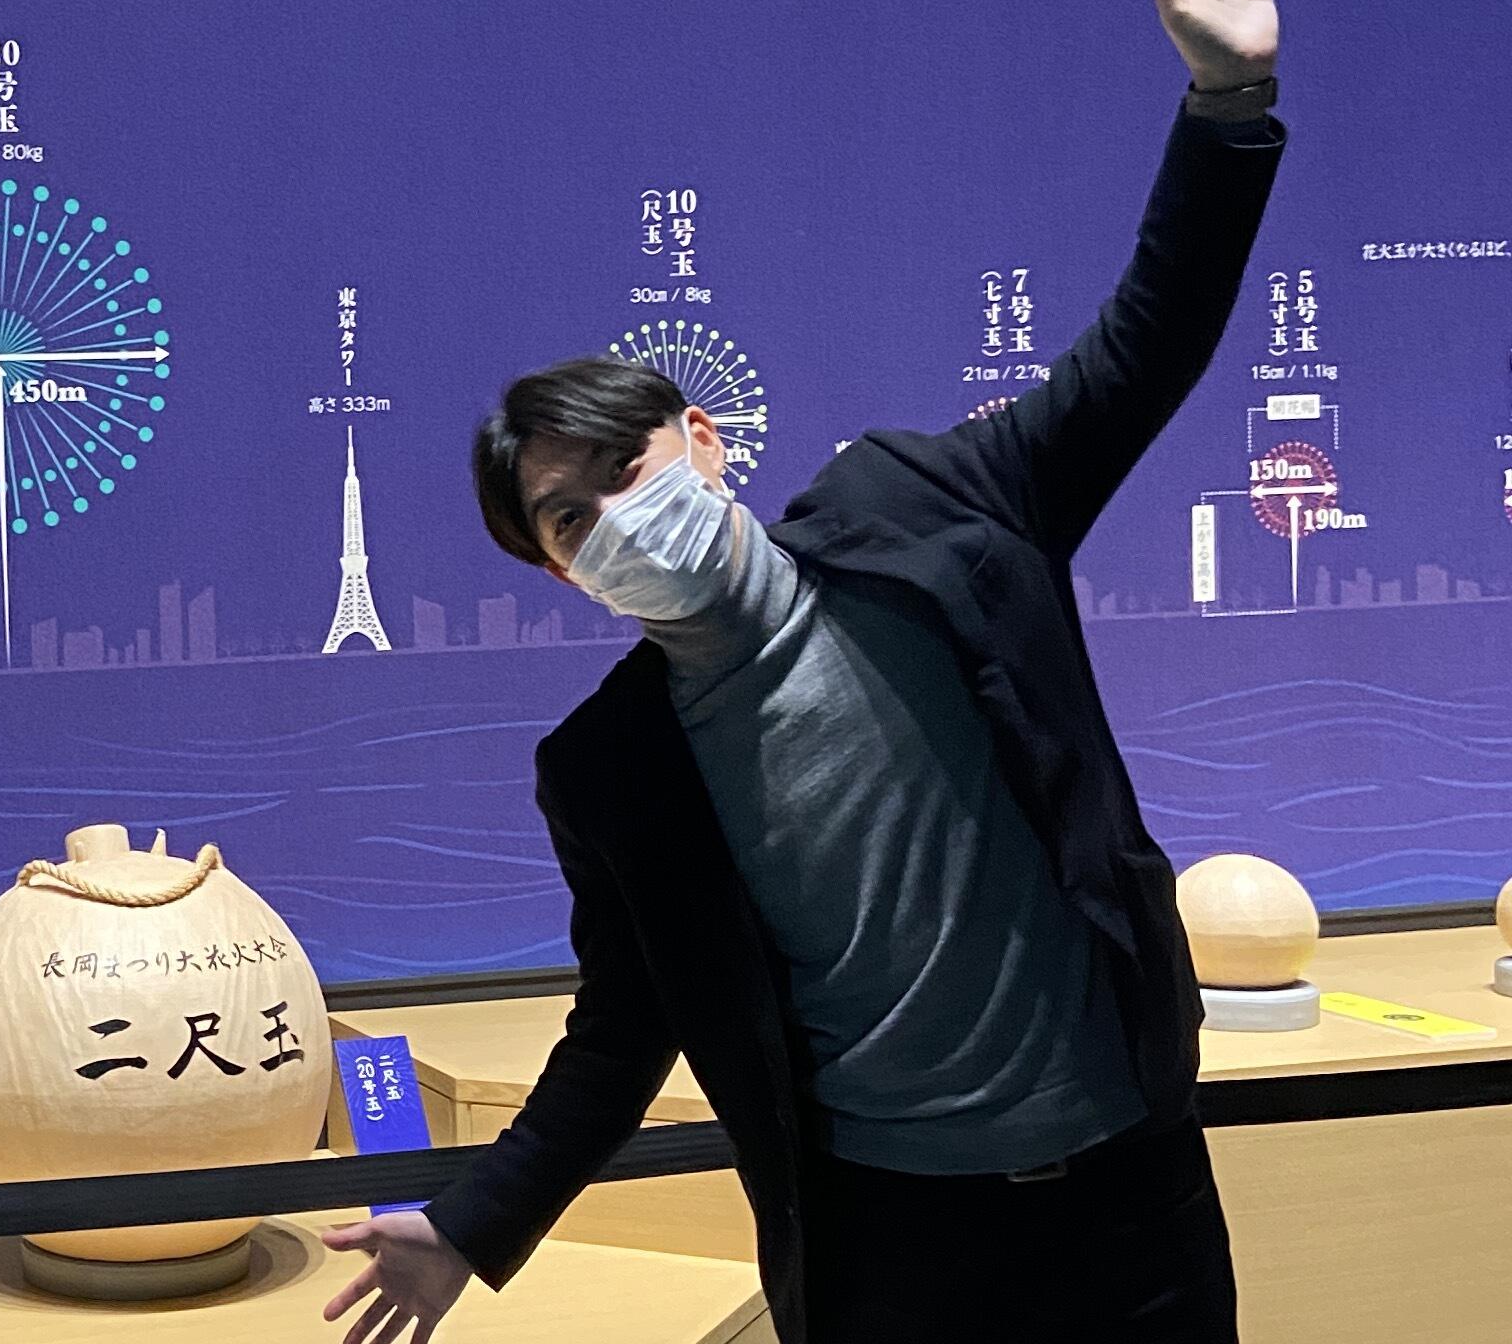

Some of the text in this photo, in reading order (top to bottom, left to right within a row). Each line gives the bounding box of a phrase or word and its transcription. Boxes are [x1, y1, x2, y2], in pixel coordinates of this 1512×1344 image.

[2, 144, 44, 162] 80kg
[666, 189, 697, 277] 10号玉
[1007, 268, 1034, 353] 7号玉
[1294, 269, 1319, 352] 5号玉
[337, 286, 357, 387] 東京タワー
[8, 379, 88, 403] 450m
[308, 396, 391, 414] 高さ 333m
[1249, 458, 1314, 481] 150m
[1303, 508, 1368, 532] 190m
[74, 1000, 304, 1081] 二尺玉
[378, 1054, 402, 1102] 二尺玉
